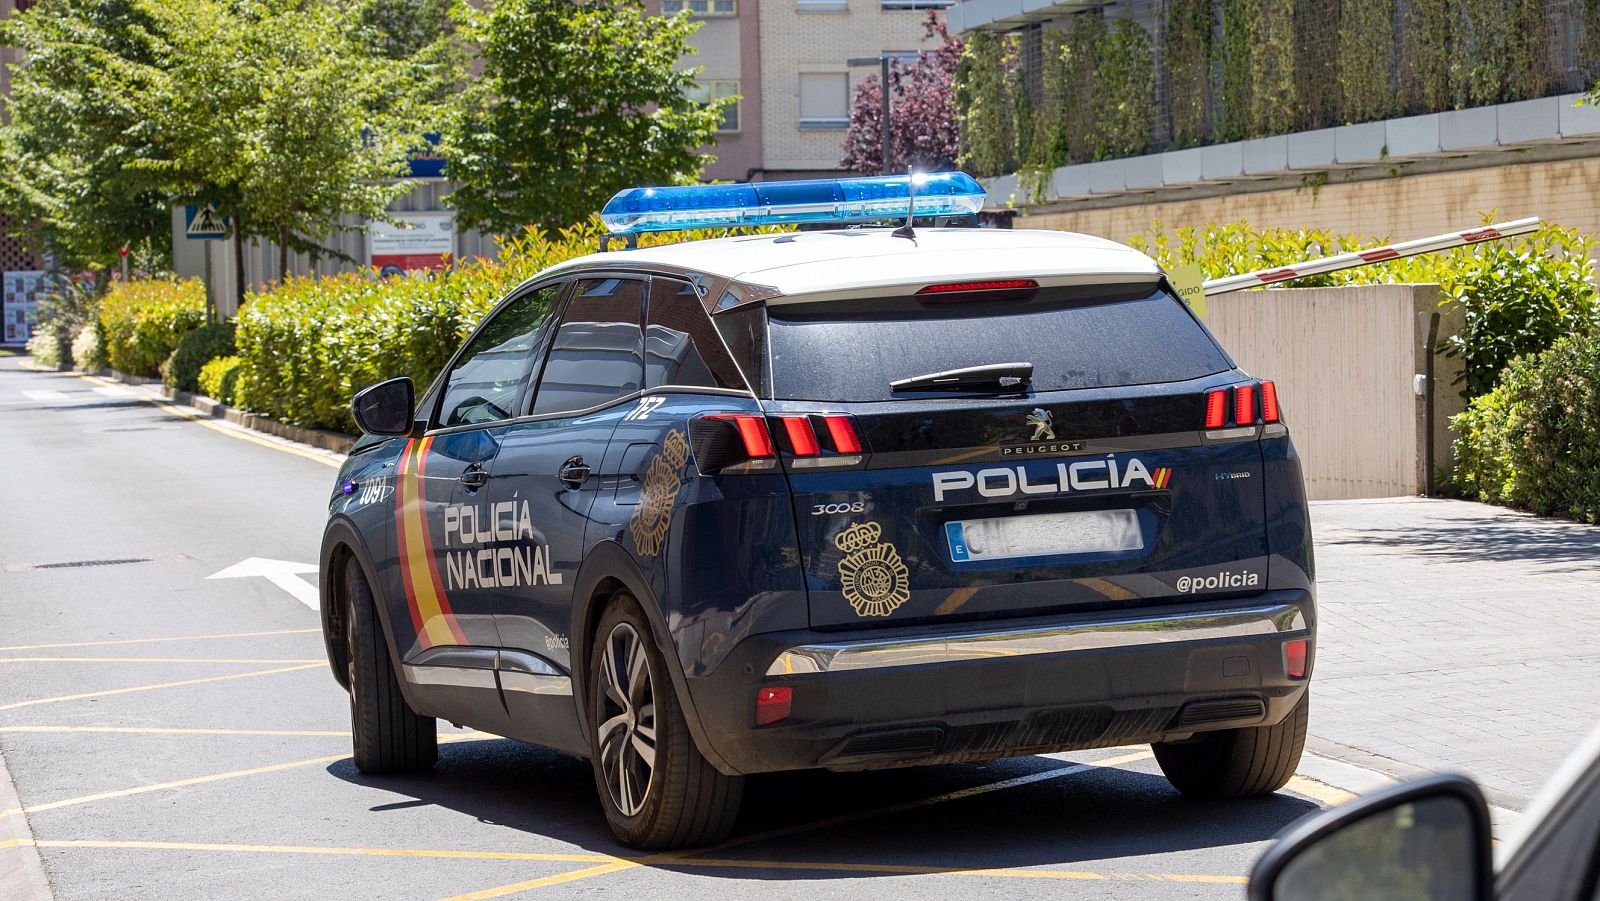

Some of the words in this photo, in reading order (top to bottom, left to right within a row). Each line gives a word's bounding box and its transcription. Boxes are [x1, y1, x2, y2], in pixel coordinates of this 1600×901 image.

[1178, 286, 1200, 297] GIDO
[1004, 443, 1081, 455] PEUGEOT
[932, 453, 1155, 502] POLICÍA
[1215, 471, 1251, 480] HYBRID
[360, 475, 387, 505] 1091
[444, 490, 534, 546] POLICÍA
[811, 501, 865, 516] 3008
[955, 545, 964, 554] E
[446, 544, 563, 590] NACIONAL
[1176, 570, 1259, 594] @policia
